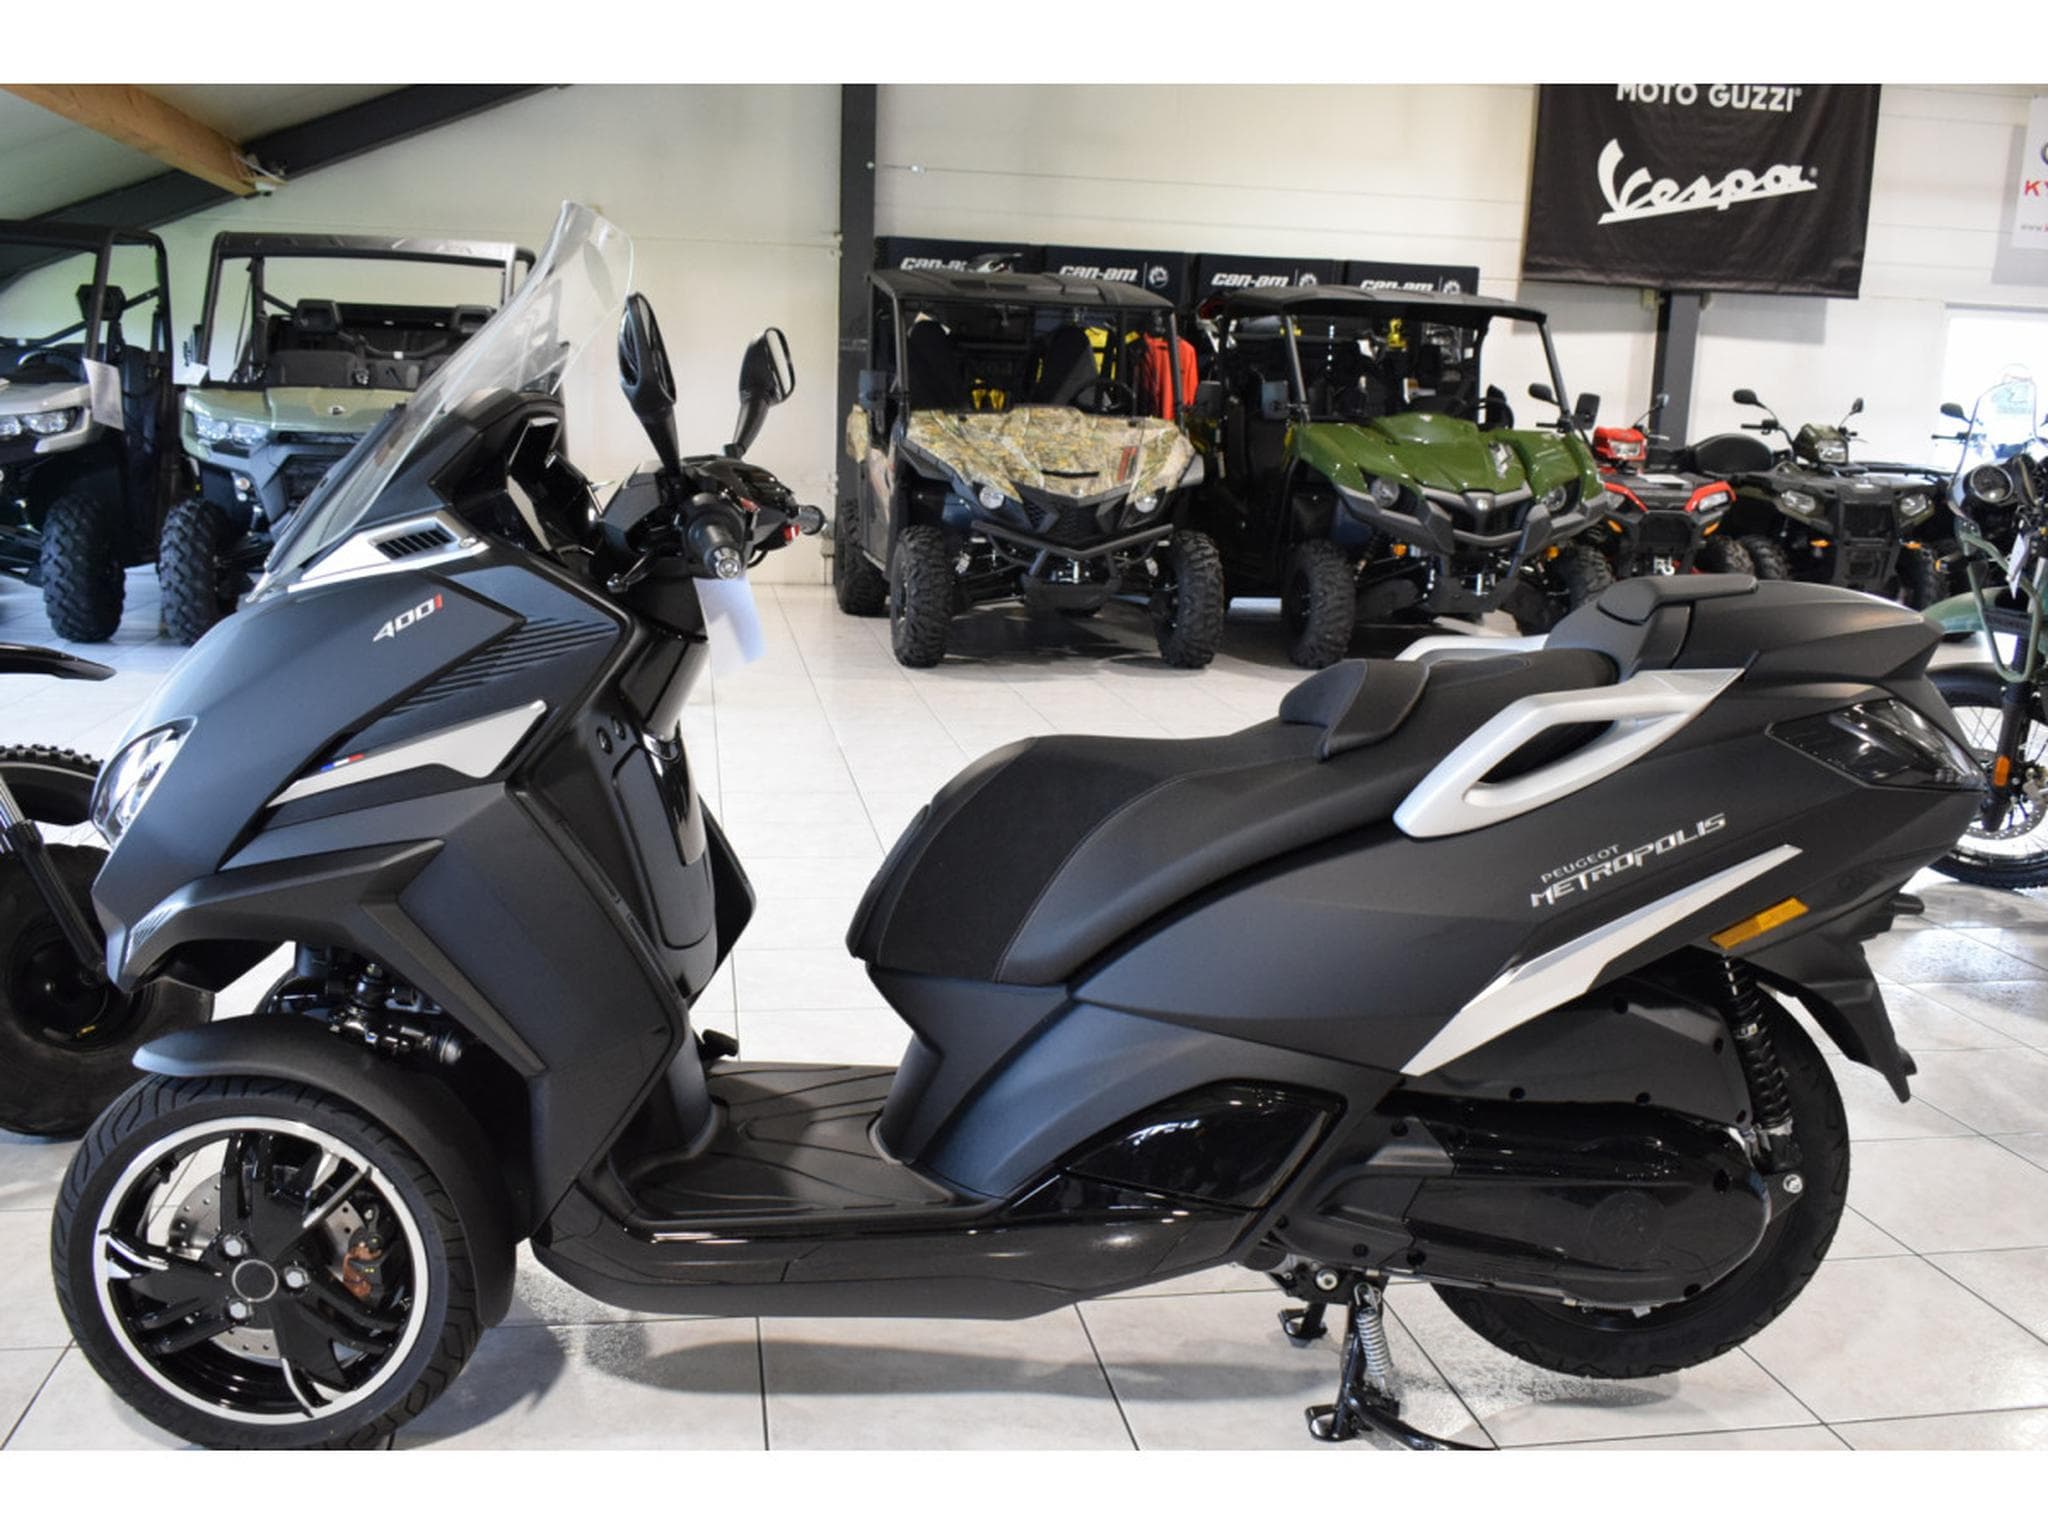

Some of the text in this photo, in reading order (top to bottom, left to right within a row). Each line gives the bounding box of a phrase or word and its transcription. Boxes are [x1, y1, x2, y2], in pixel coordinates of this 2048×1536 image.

[1616, 84, 1698, 105] MOTO
[1597, 138, 1818, 225] Vespa
[1059, 264, 1139, 281] can-am
[1211, 272, 1289, 288] can-am
[1530, 812, 1727, 908] METROPOLIS
[1540, 843, 1620, 883] PEUGEOT
